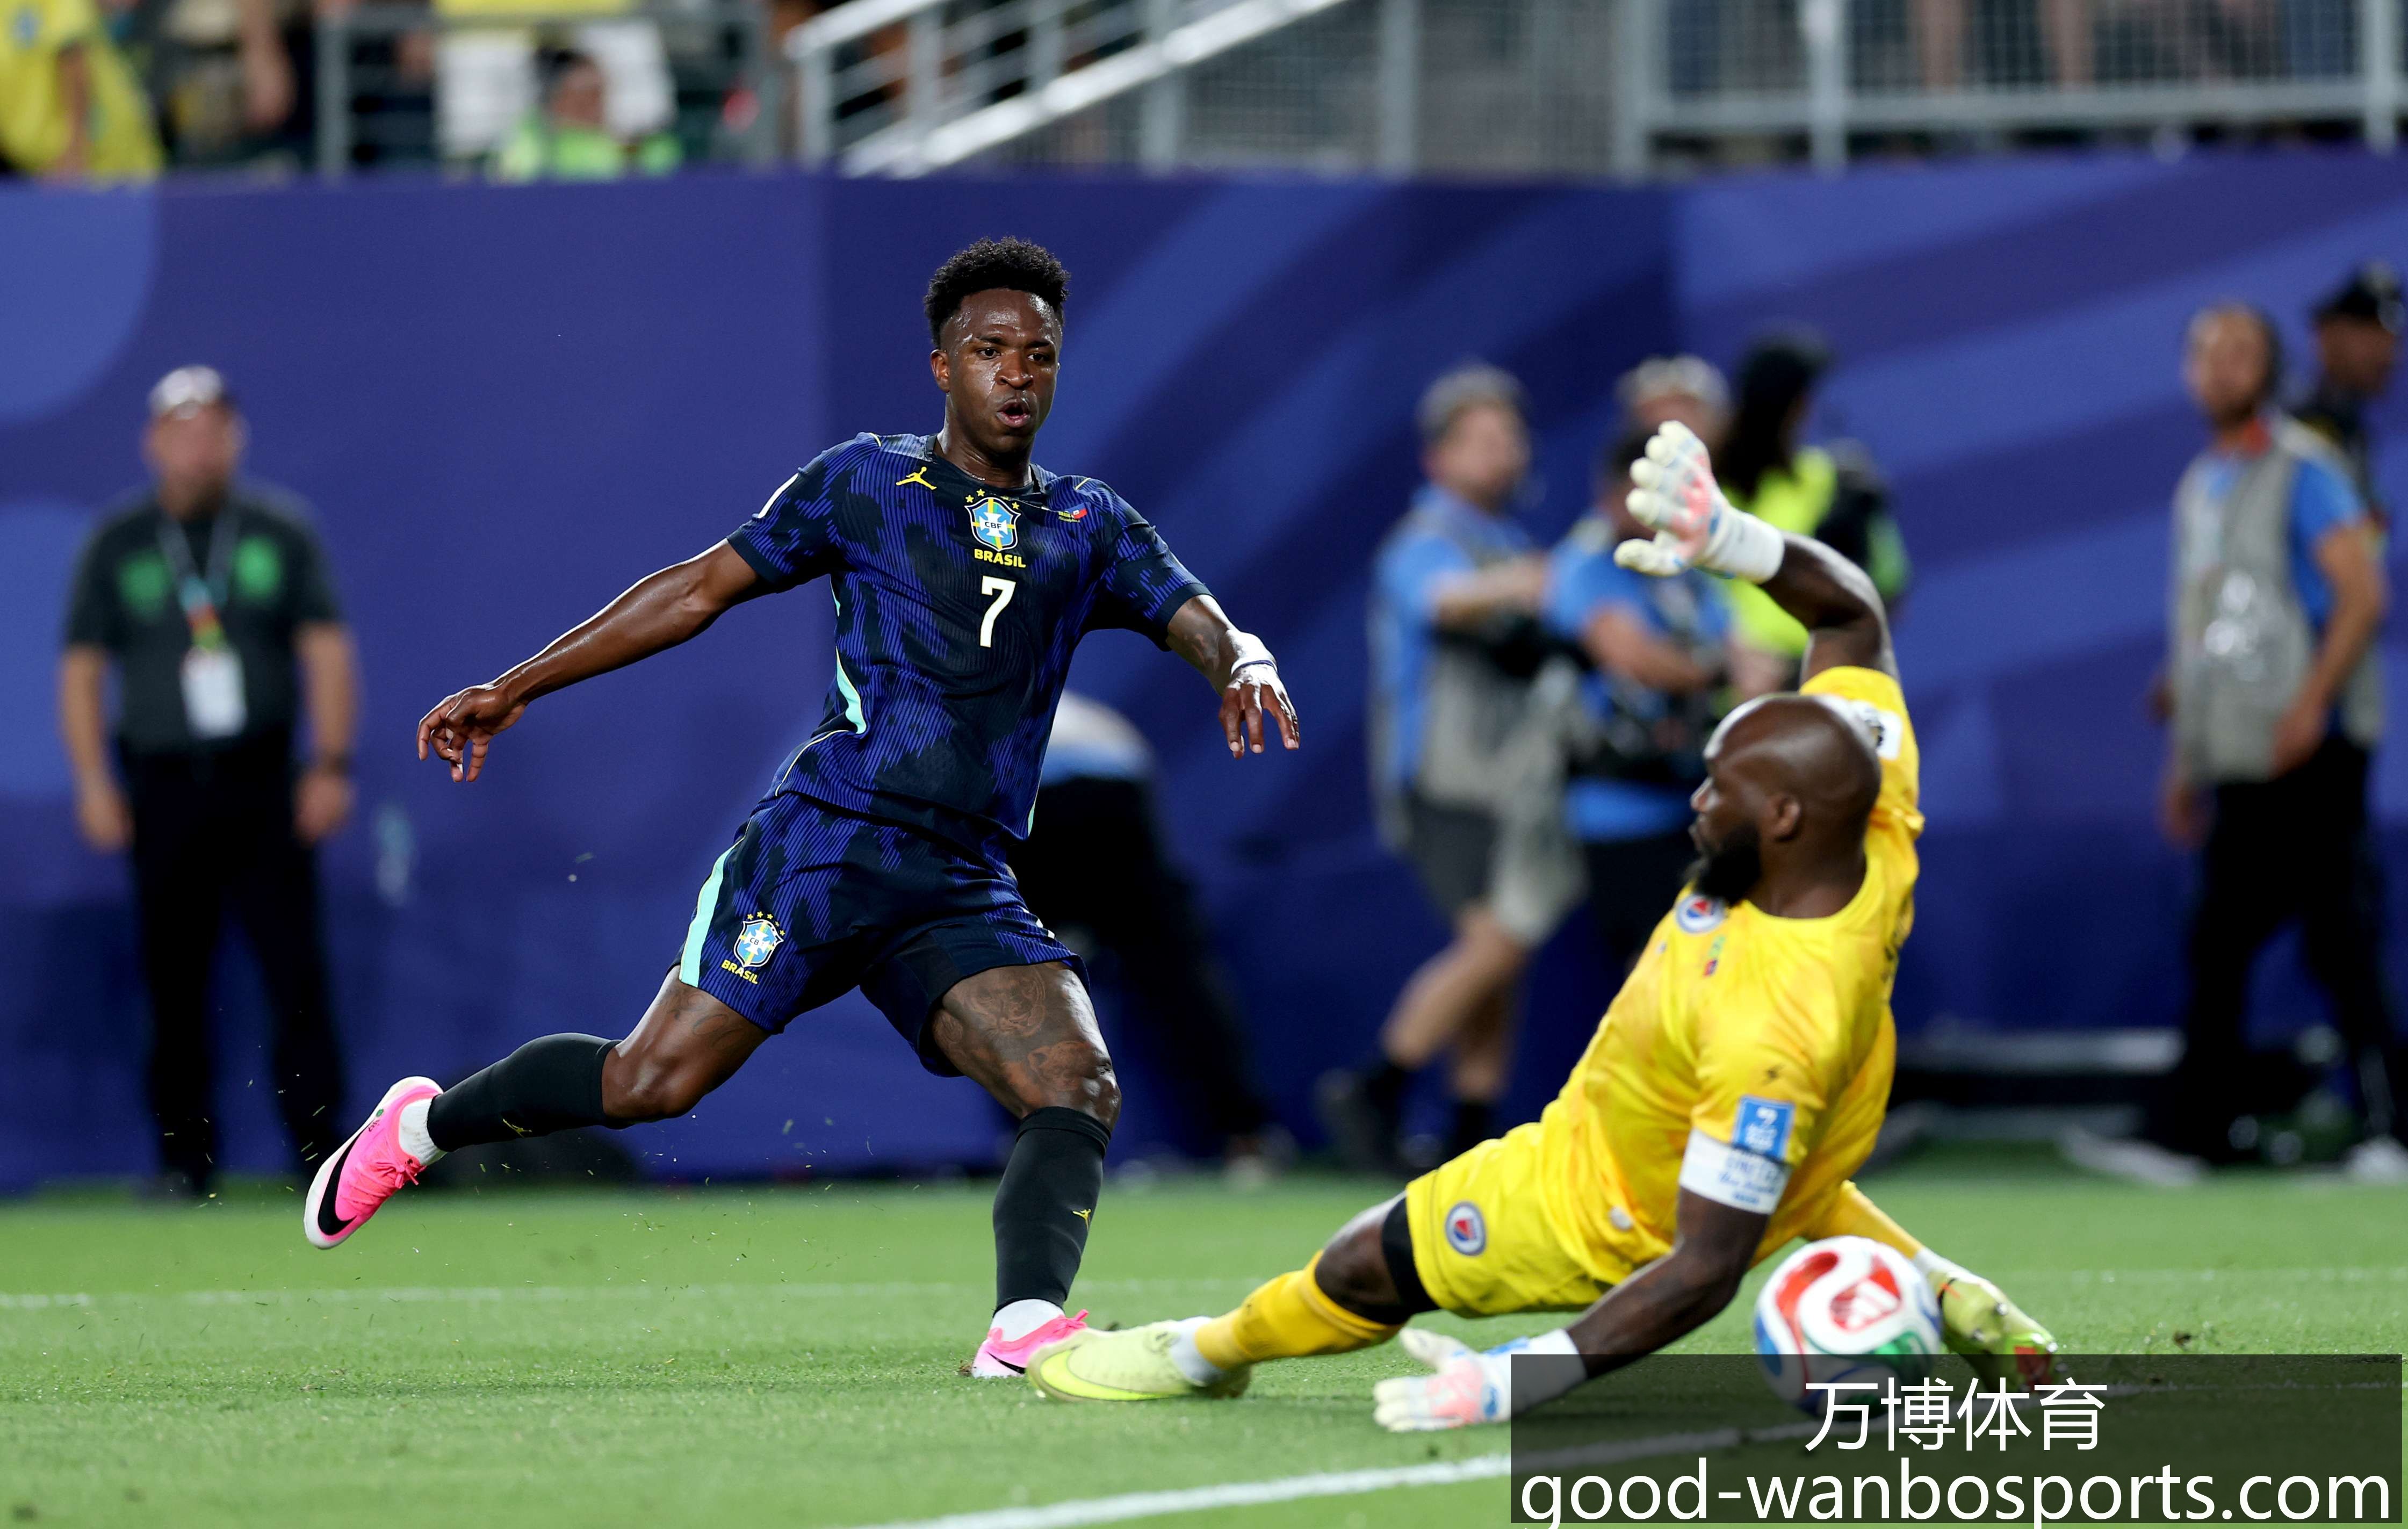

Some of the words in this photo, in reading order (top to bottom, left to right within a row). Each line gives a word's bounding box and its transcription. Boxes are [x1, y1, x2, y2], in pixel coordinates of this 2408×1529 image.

[974, 548, 1026, 568] BRASIL
[980, 575, 1016, 648] 7
[721, 959, 758, 985] BRASIL
